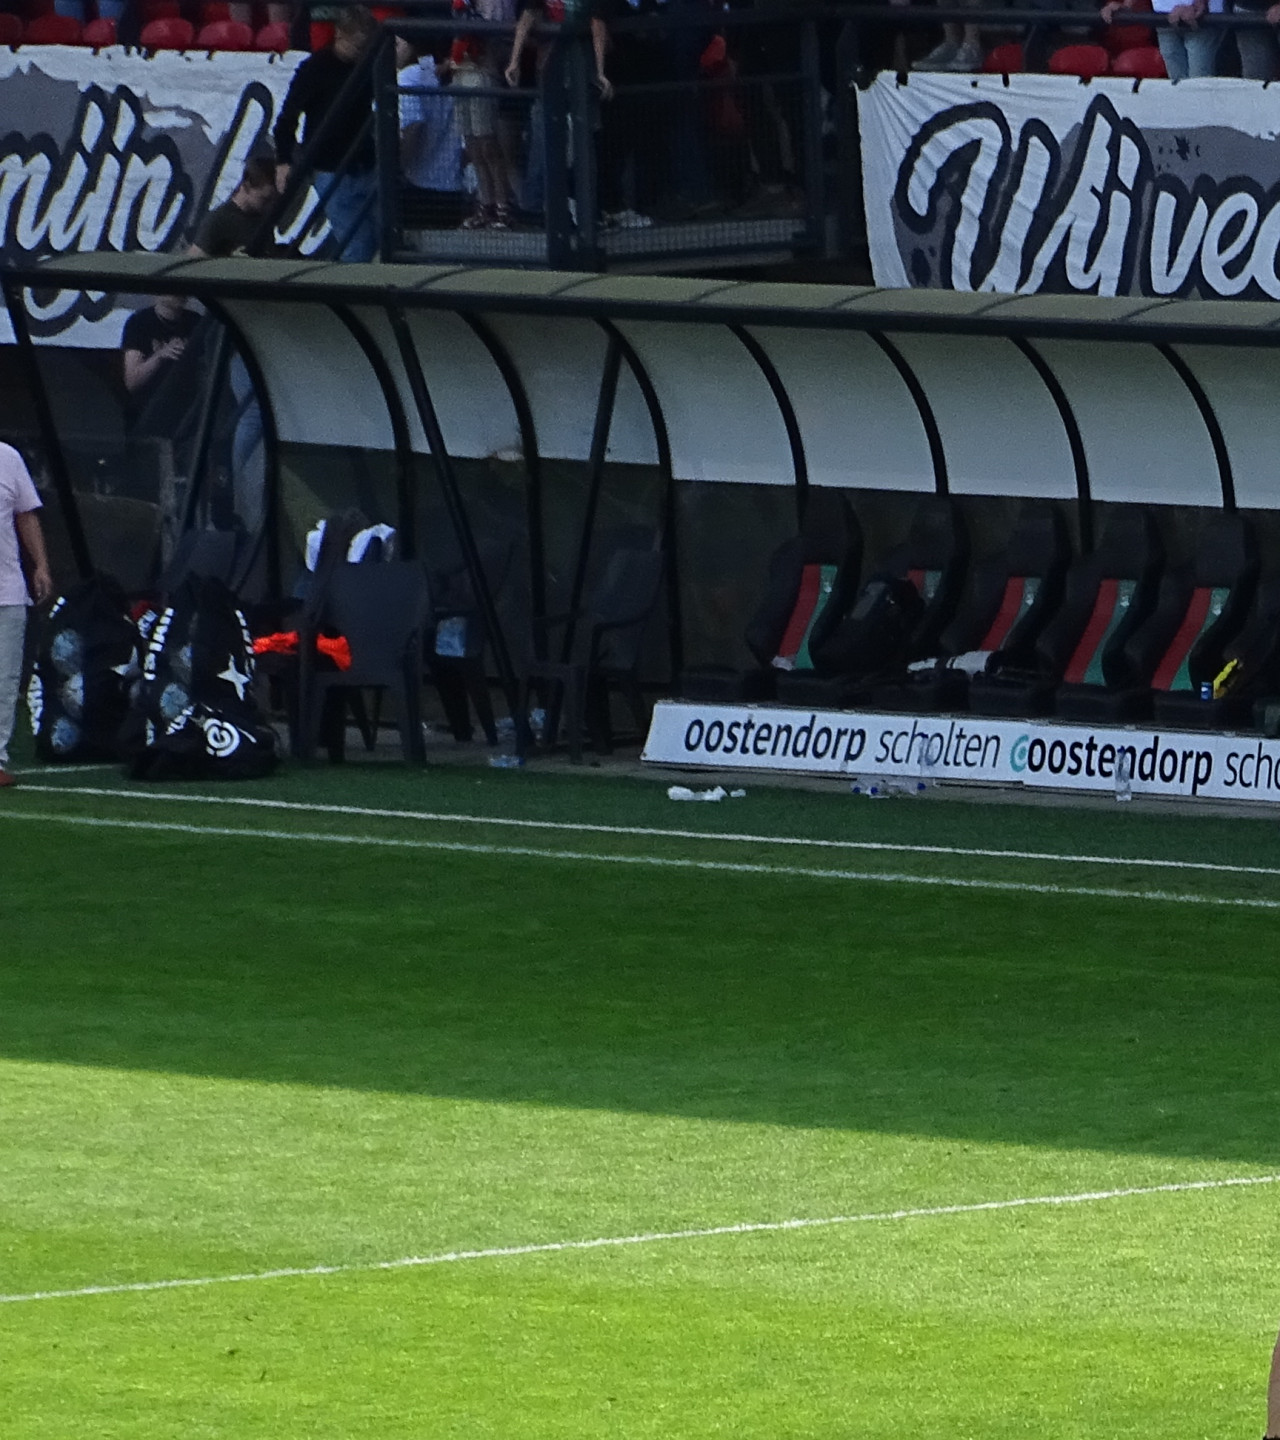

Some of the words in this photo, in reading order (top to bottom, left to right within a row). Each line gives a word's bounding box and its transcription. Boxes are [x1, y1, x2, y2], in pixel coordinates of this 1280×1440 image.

[907, 109, 1142, 298] Wij
[684, 714, 867, 763] oostendorp
[874, 719, 1001, 768] scholten
[1027, 734, 1213, 796] oostendorp
